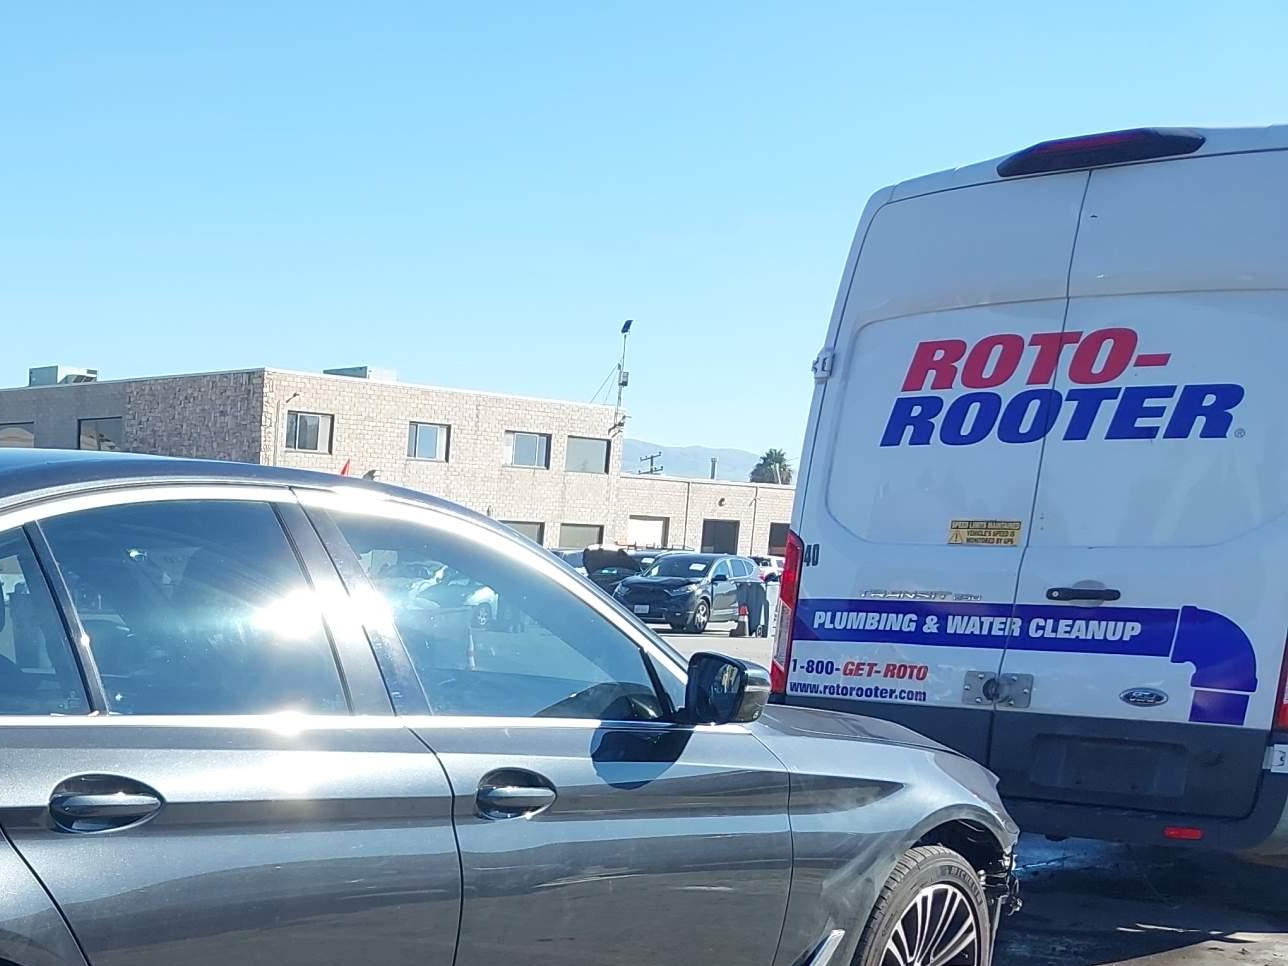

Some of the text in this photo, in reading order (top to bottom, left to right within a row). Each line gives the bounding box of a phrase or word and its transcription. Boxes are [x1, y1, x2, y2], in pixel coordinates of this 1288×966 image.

[900, 326, 1172, 392] ROTO-
[813, 611, 1142, 641] PLUMBING & WATER CLEANUP
[789, 681, 927, 702] www.rotorooter.com
